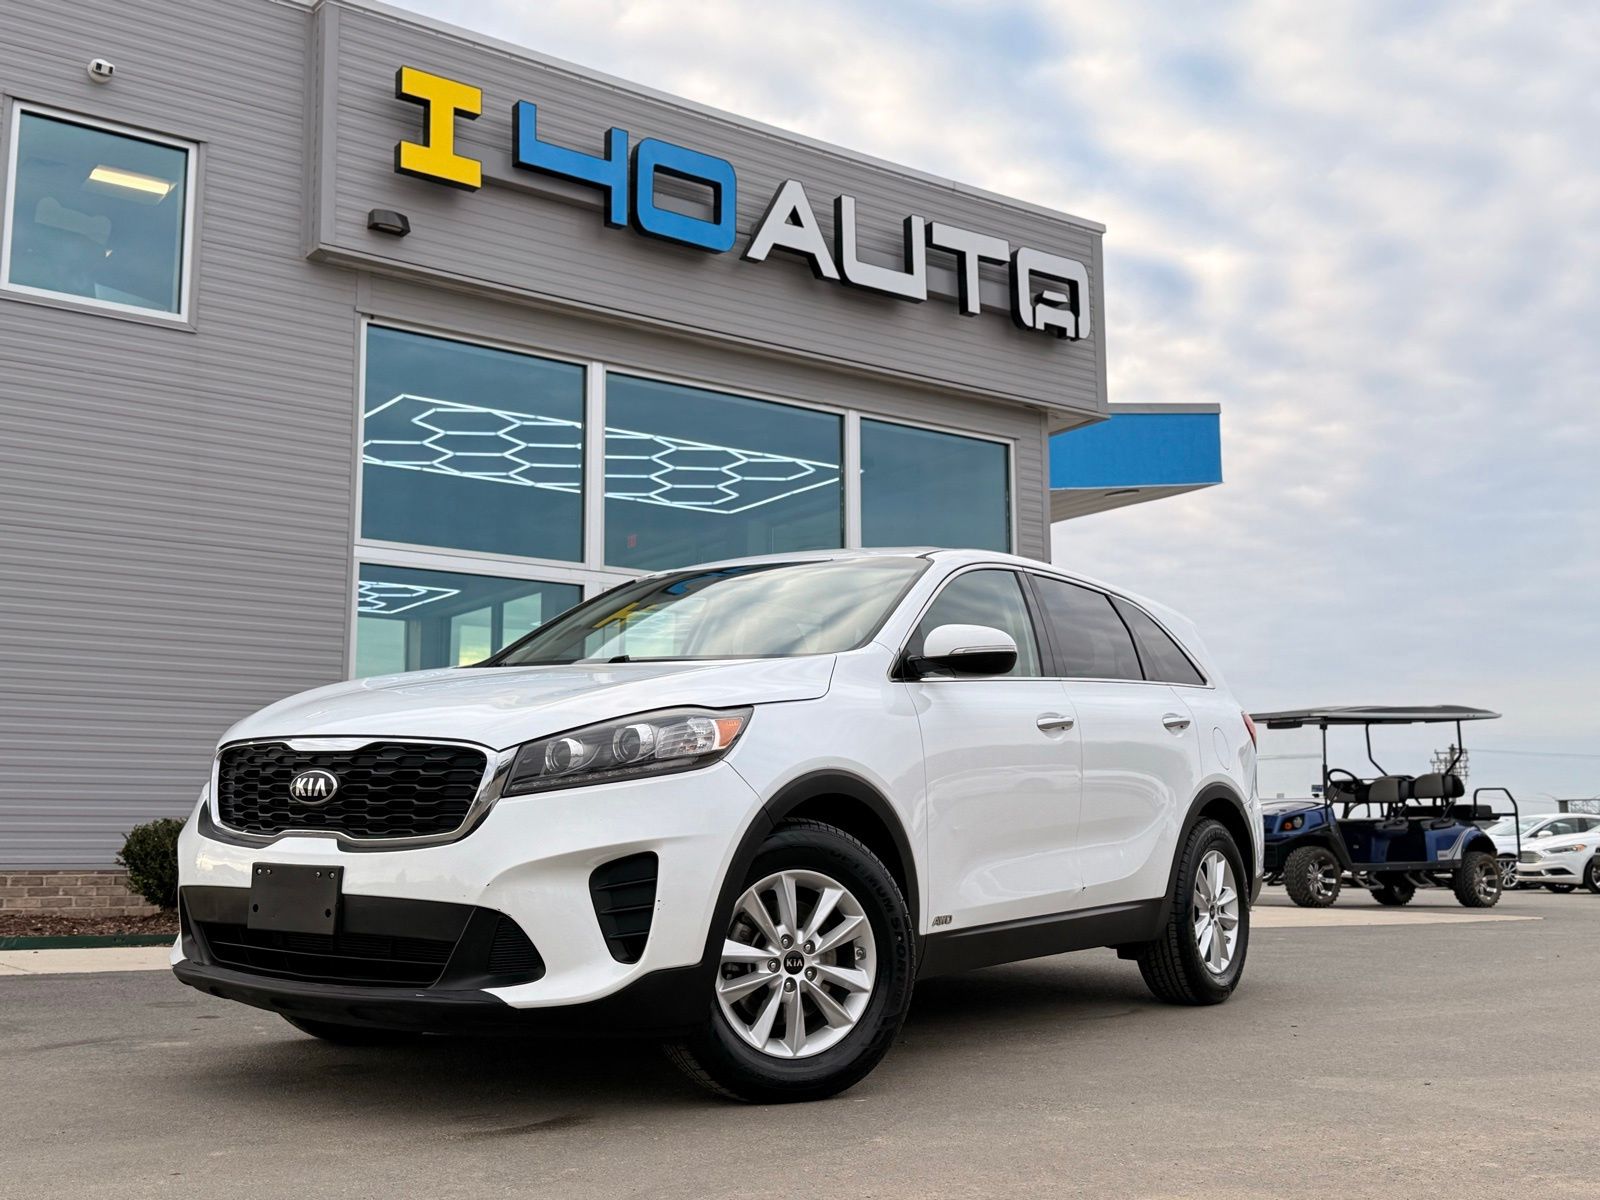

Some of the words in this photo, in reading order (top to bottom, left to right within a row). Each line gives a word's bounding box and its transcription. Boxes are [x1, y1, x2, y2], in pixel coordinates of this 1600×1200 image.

[395, 65, 482, 192] I
[512, 100, 736, 254] 40
[295, 777, 327, 797] KIA
[932, 914, 953, 926] AWD
[786, 958, 804, 967] KIA
